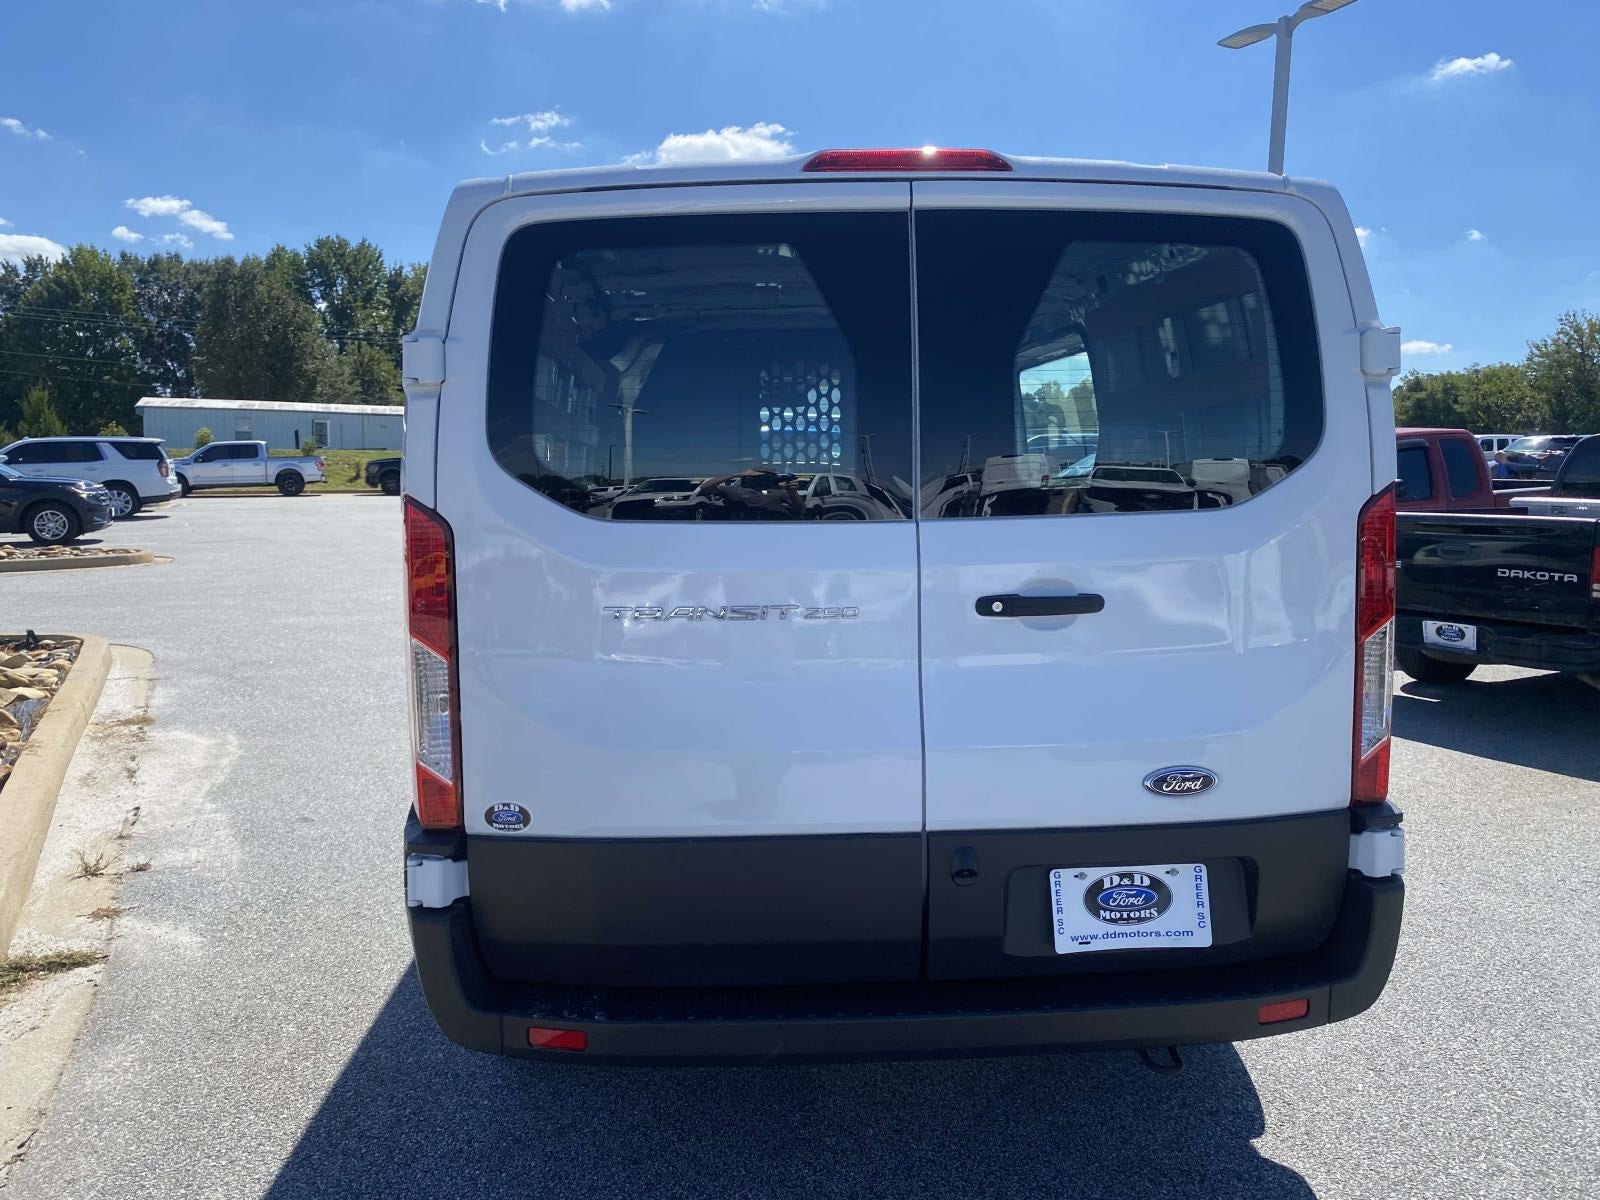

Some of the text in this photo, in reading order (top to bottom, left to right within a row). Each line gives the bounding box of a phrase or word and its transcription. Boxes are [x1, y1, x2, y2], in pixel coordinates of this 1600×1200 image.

[1497, 568, 1578, 583] DAKOTA
[603, 604, 860, 622] TRANSIT 250
[1162, 773, 1204, 791] Ford
[493, 804, 520, 812] D&D
[497, 813, 517, 822] Ford
[1103, 873, 1151, 890] D&D
[1053, 871, 1065, 935] GREER SC
[1109, 890, 1145, 906] Ford
[1193, 865, 1206, 929] GREER SC
[1099, 907, 1159, 920] MOTORS
[1070, 928, 1194, 942] www.ddmotors.com
